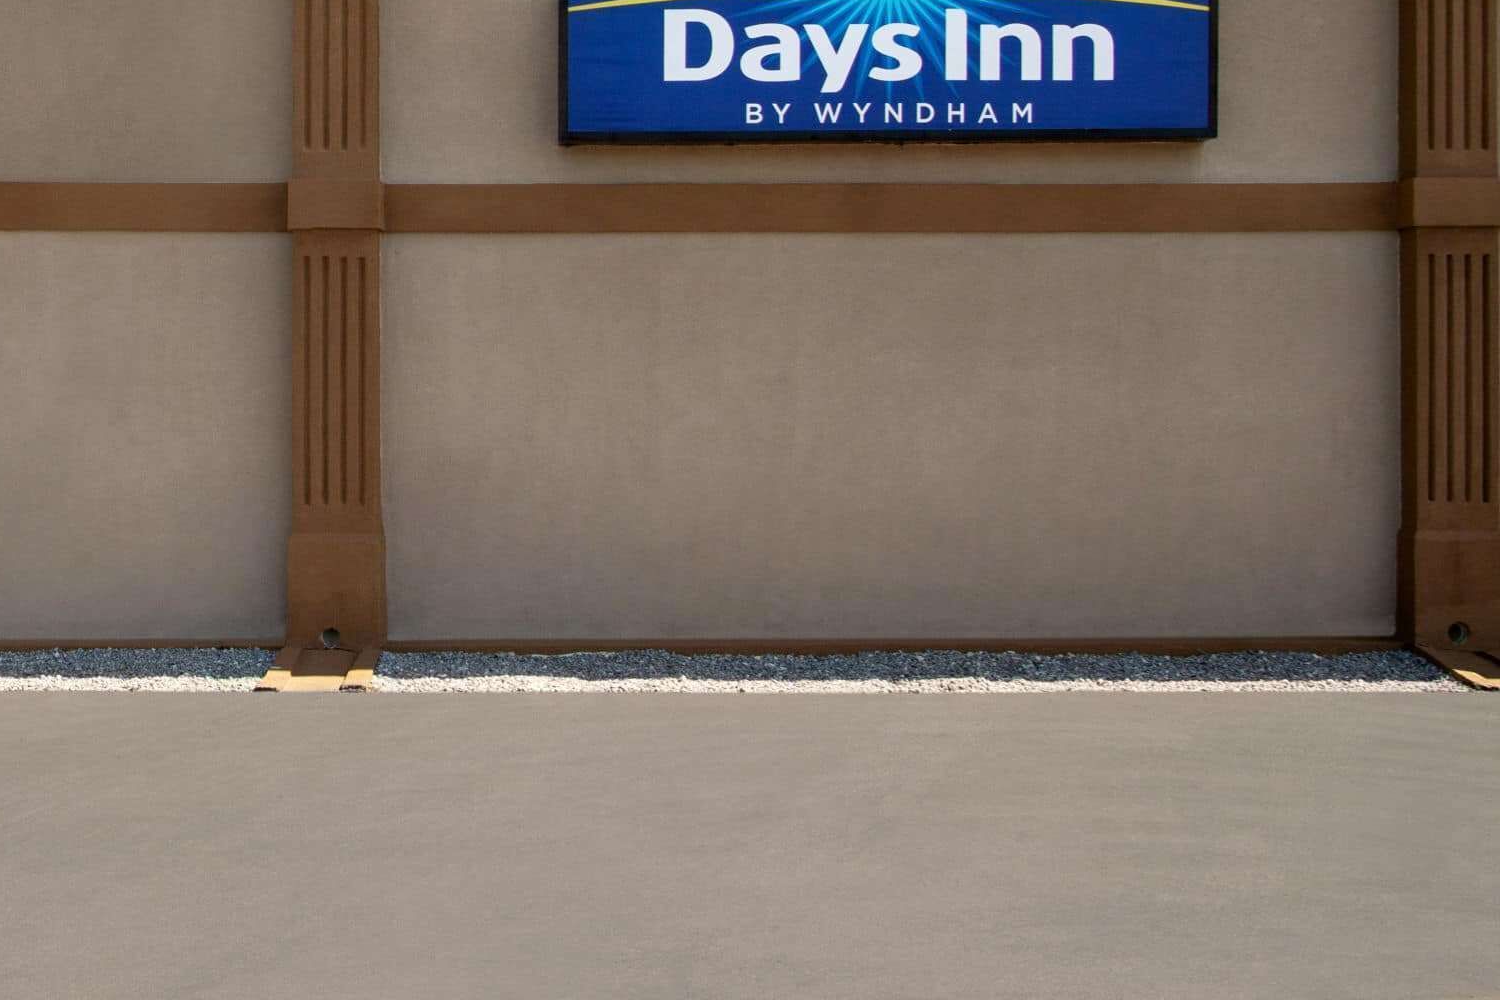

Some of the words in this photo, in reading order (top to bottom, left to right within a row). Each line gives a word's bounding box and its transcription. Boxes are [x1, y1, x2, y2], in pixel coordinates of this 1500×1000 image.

[663, 8, 923, 93] Days
[945, 8, 1114, 82] Inn
[745, 103, 791, 124] BY
[814, 102, 1033, 124] WYNDHAM
